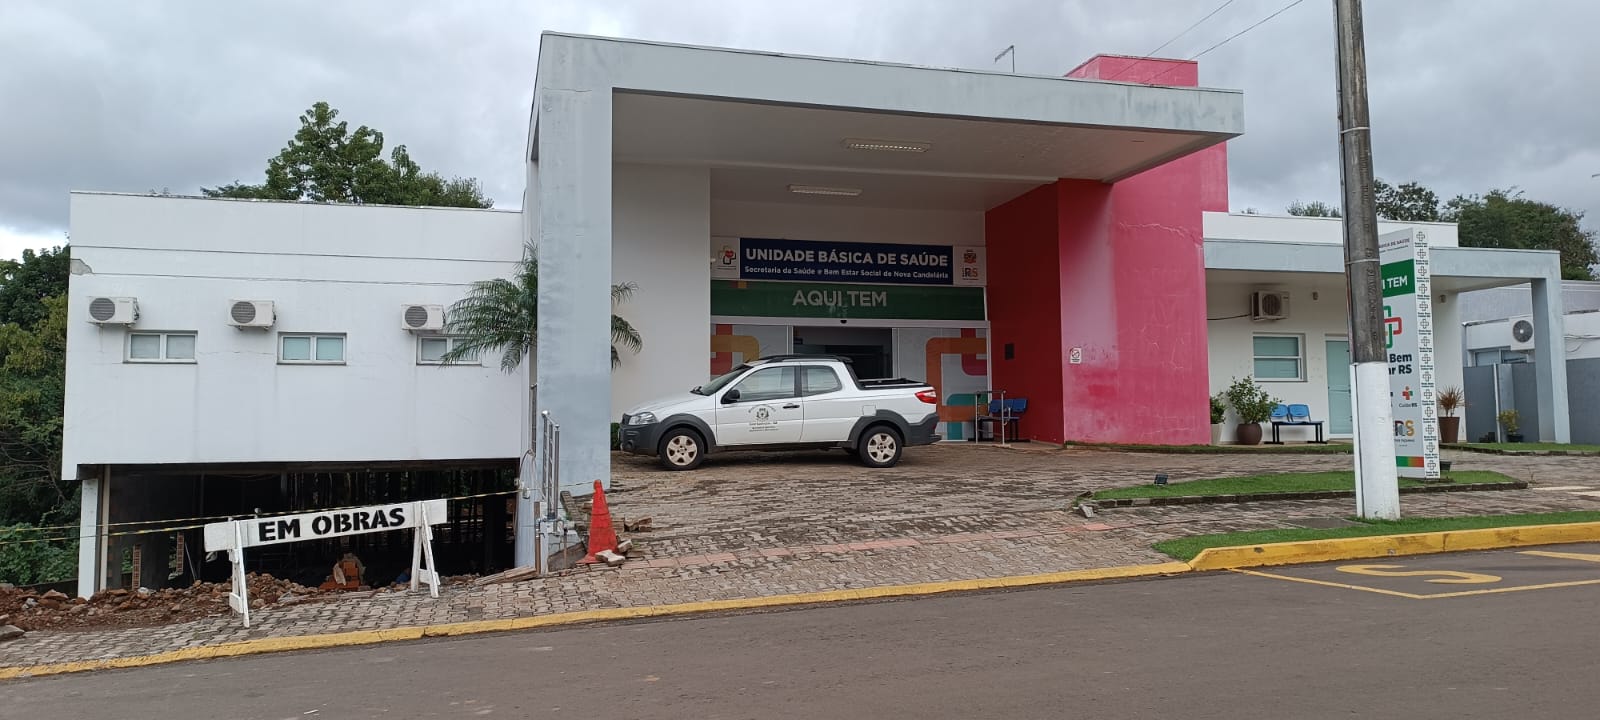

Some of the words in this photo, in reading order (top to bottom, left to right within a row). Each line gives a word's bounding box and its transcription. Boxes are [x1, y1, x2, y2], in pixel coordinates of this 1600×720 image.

[745, 248, 815, 262] UNIDADE
[818, 249, 873, 264] BÁSICA
[877, 252, 897, 265] DE
[900, 252, 948, 266] SAÚDE
[1386, 275, 1408, 288] TEM
[792, 290, 842, 307] AQUI
[846, 290, 887, 307] TEM
[1389, 353, 1412, 363] Bem
[1398, 364, 1412, 375] RS
[258, 518, 301, 542] EM
[311, 507, 405, 535] OBRAS
